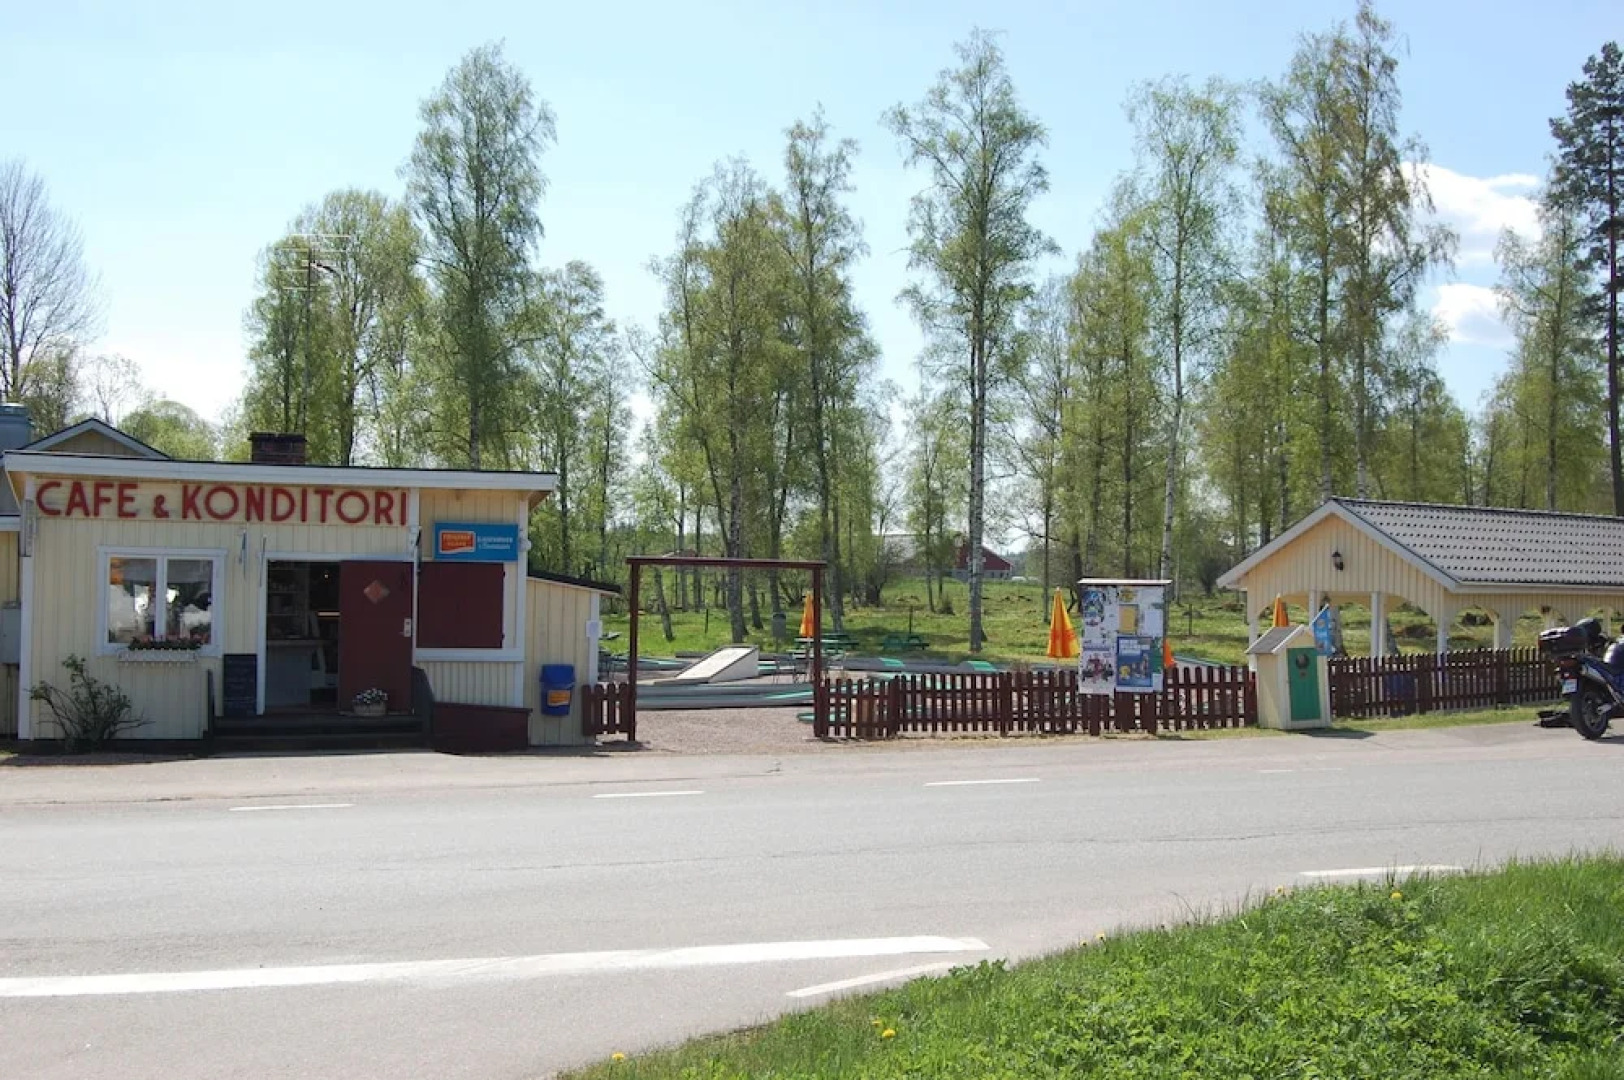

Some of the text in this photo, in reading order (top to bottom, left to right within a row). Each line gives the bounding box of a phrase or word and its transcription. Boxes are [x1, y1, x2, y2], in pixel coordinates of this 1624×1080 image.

[37, 481, 407, 526] CAFE & KONDITORI
